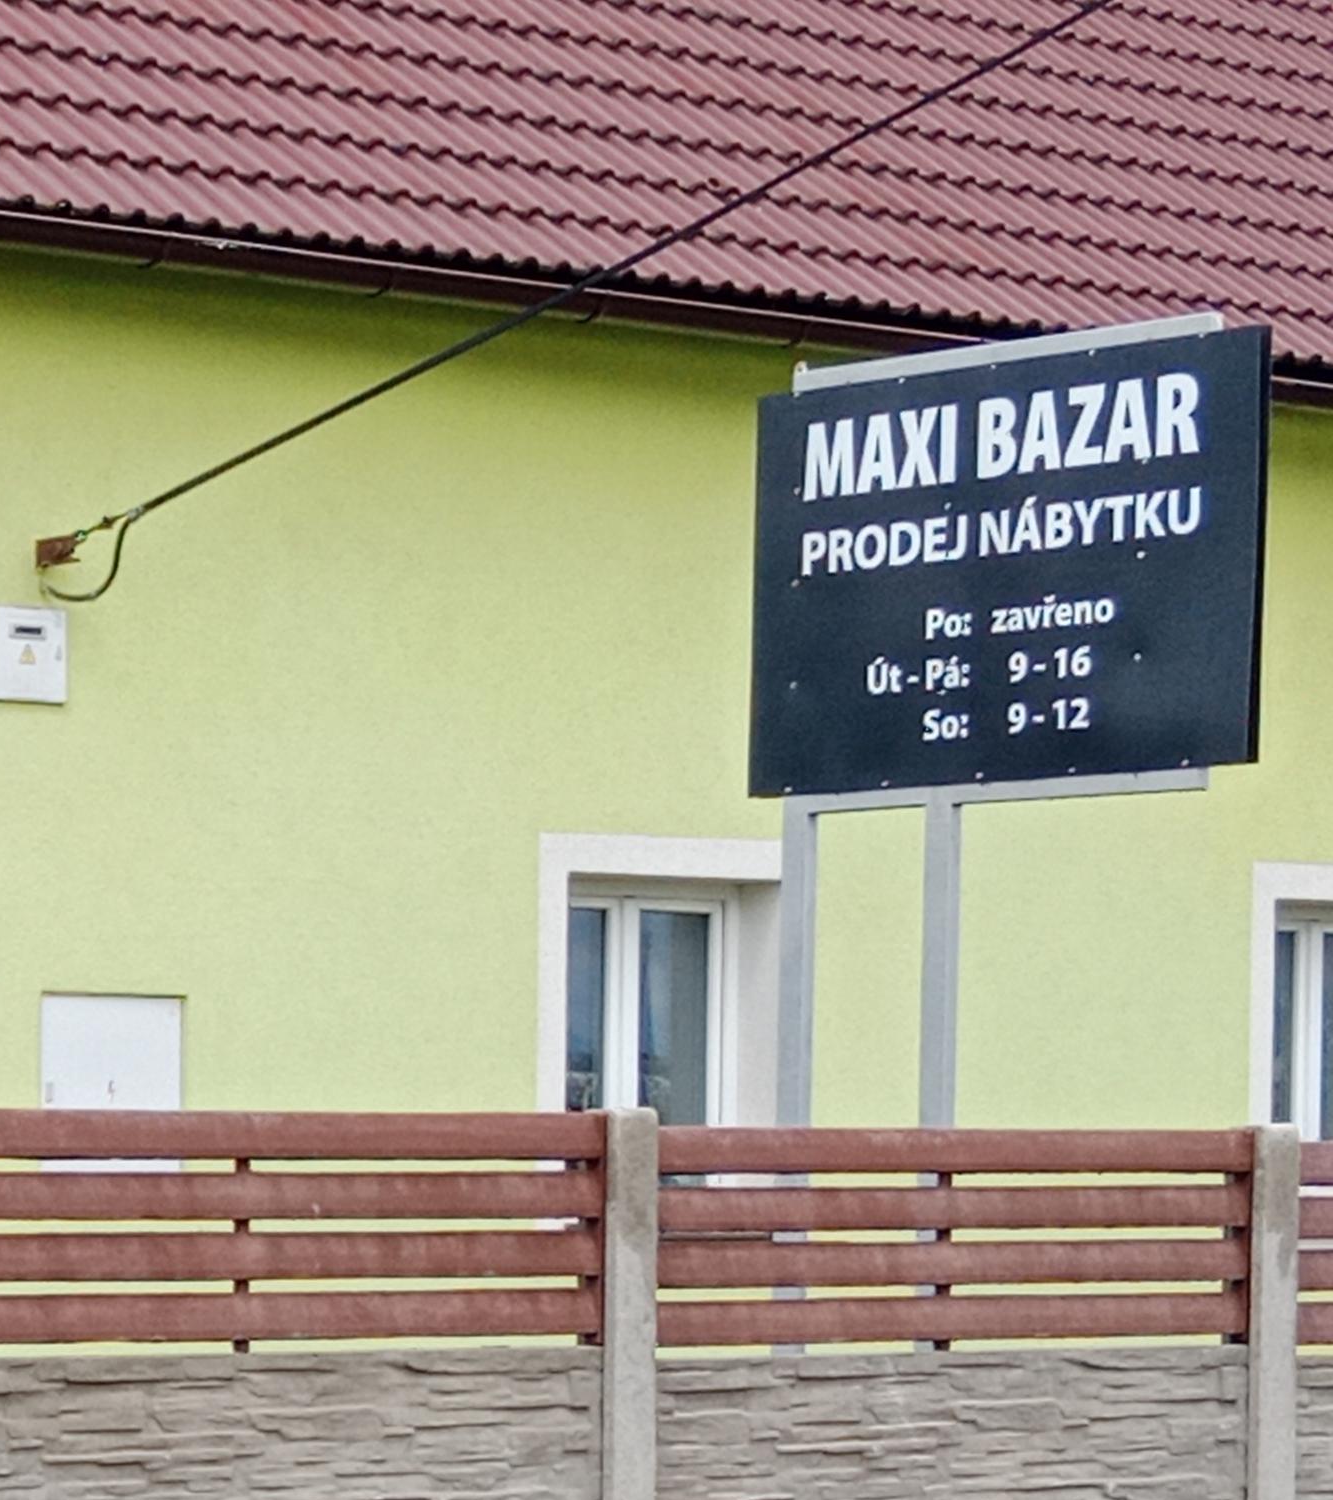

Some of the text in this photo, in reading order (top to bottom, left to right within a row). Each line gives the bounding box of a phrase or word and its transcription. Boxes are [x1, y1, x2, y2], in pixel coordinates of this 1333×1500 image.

[802, 372, 1201, 502] MAXI BAZAR
[800, 486, 1203, 576] PRODEJ NÁBYTKU
[925, 594, 1116, 641] Po: zavřeno
[921, 708, 970, 742] So:
